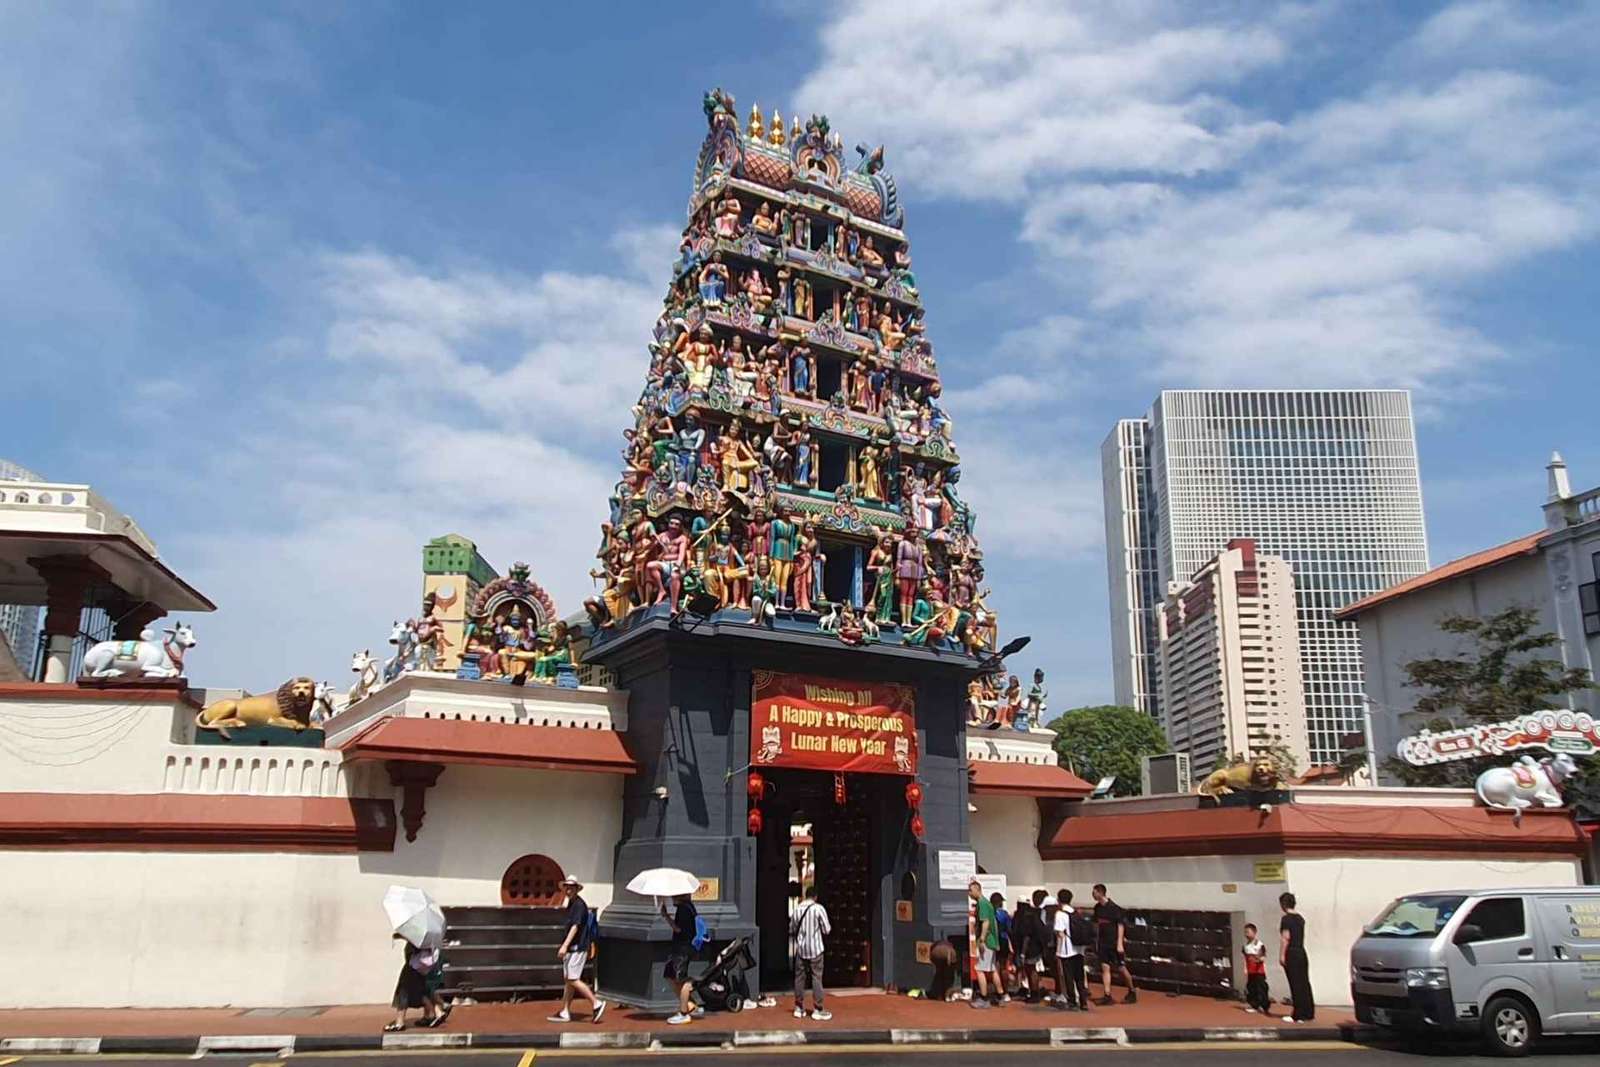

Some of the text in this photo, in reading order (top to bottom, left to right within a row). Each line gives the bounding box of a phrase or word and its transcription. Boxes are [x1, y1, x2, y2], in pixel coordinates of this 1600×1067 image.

[805, 684, 872, 706] Wishing All
[769, 705, 904, 733] A Happy & Prosperous
[791, 732, 887, 756] Lunar New Year
